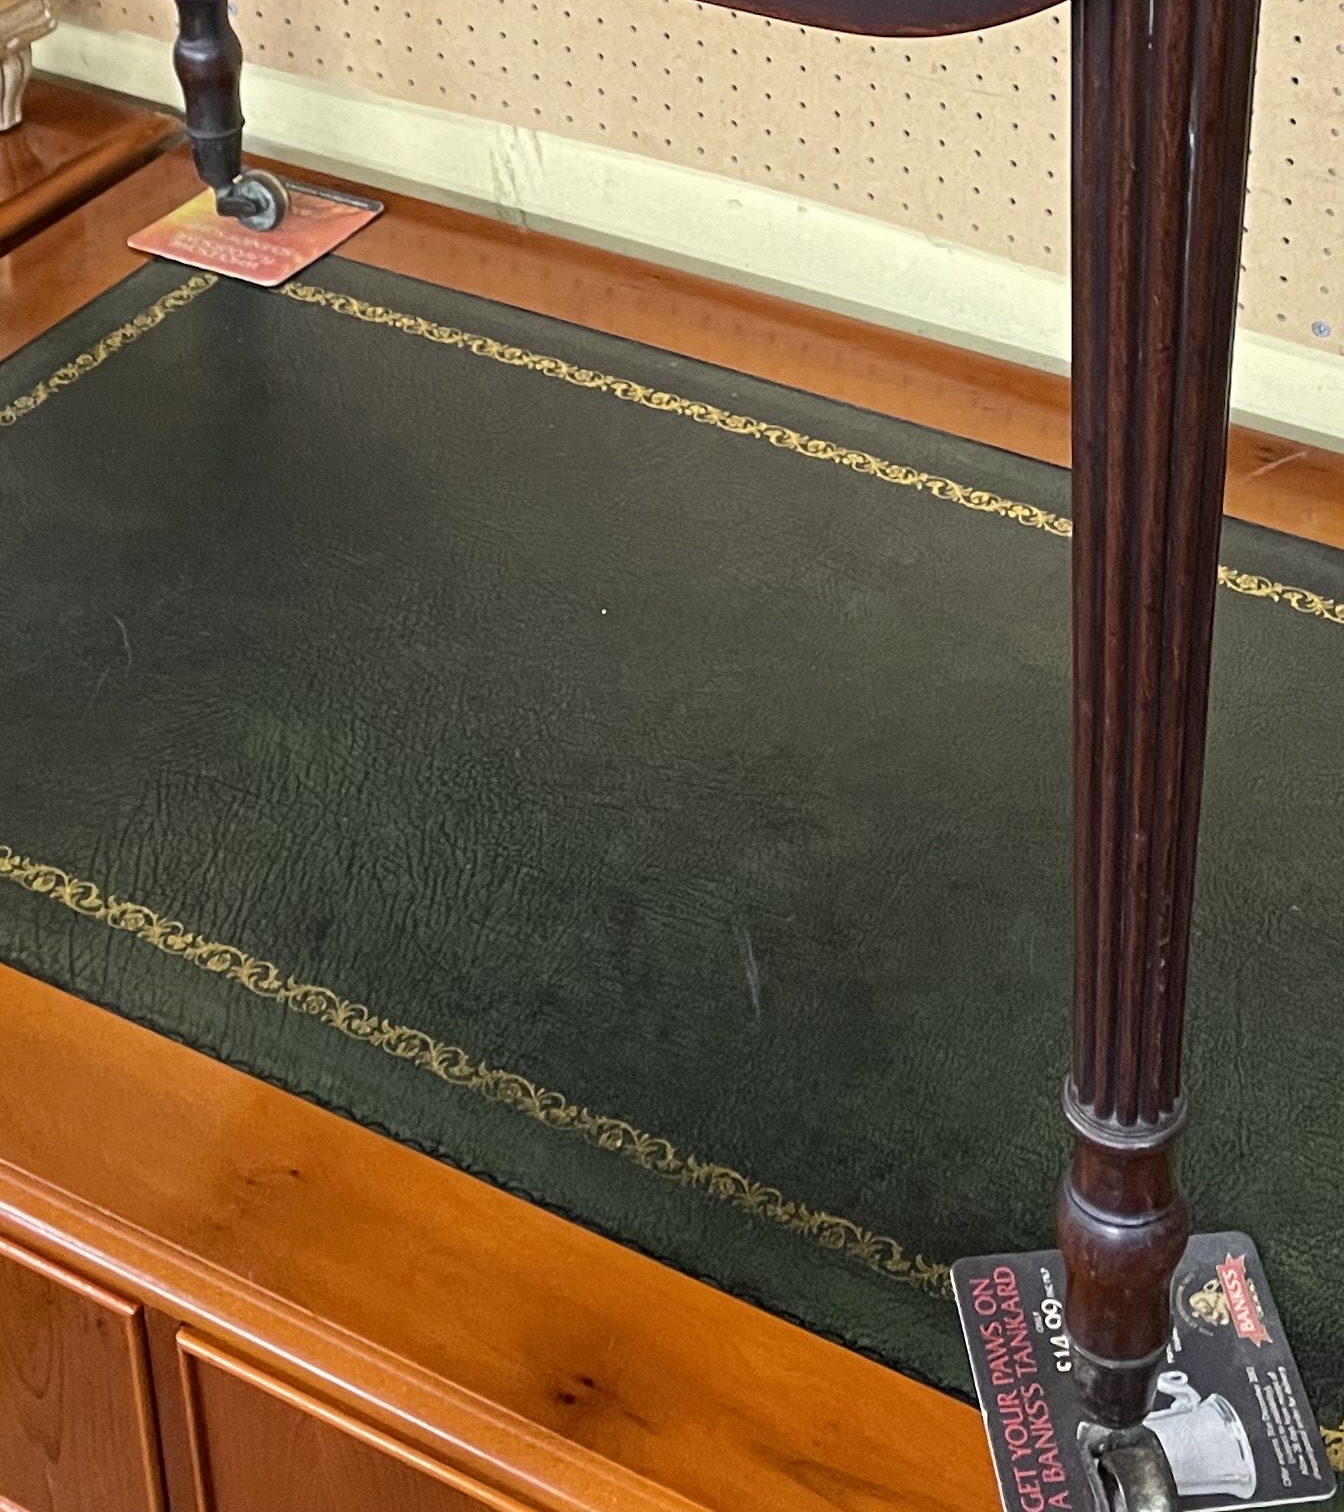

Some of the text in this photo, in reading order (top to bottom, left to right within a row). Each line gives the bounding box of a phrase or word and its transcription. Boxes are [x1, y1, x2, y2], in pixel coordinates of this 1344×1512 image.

[992, 1266, 1038, 1378] TANKARD
[969, 1277, 1045, 1512] GET YOUR PAWS ON
[1048, 1490, 1072, 1510] A
